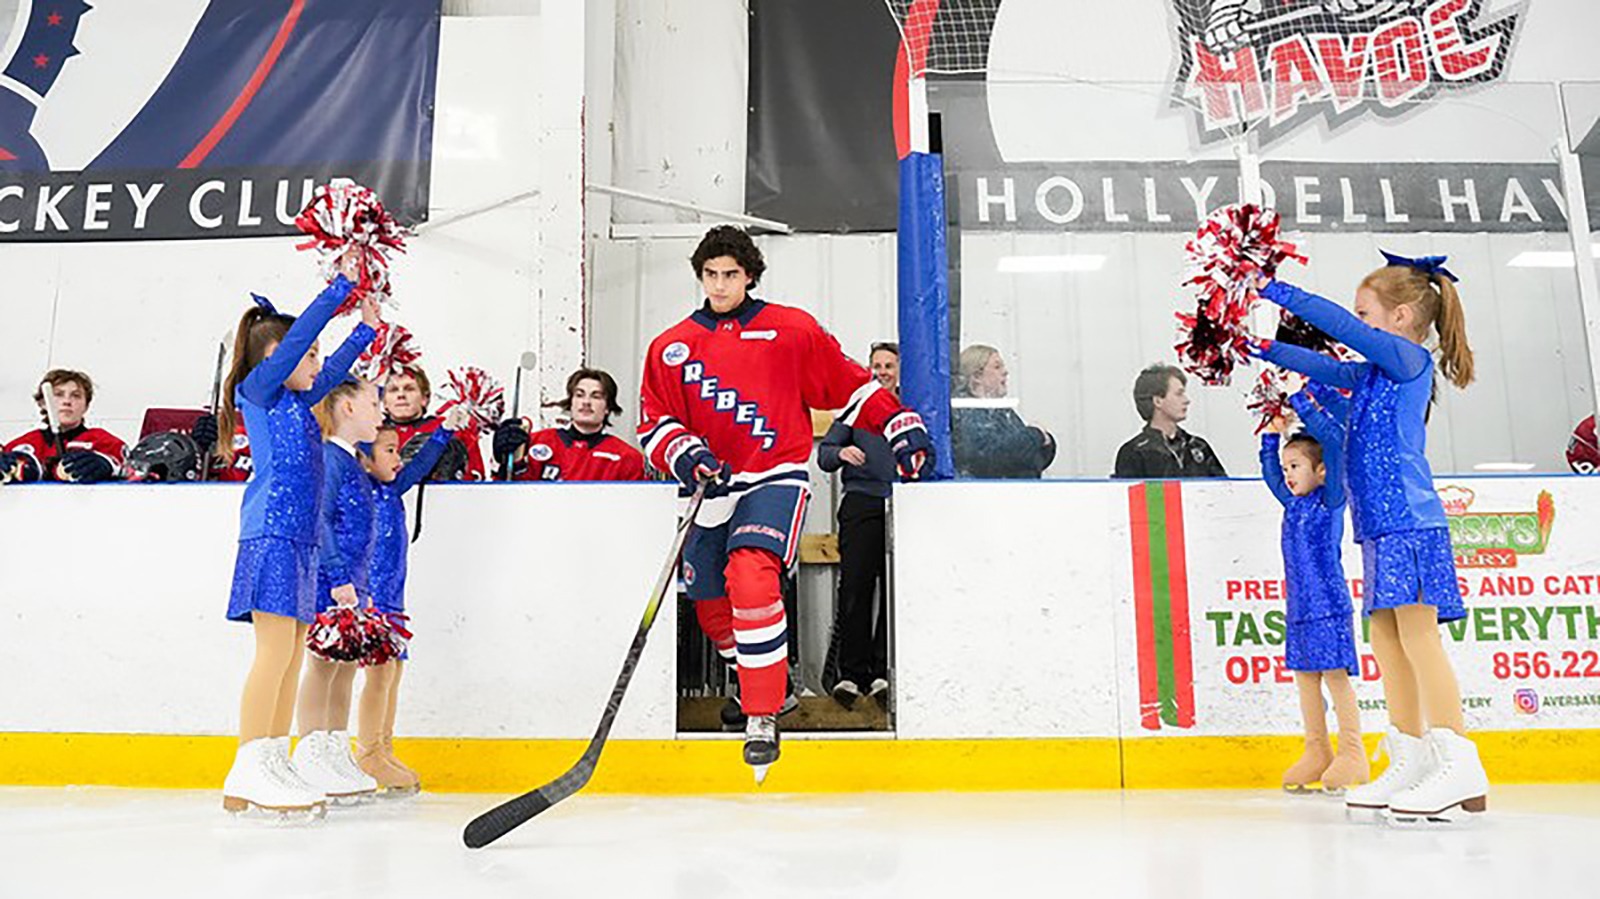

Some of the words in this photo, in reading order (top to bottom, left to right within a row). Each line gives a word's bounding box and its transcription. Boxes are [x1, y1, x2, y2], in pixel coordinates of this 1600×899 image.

[1184, 0, 1503, 131] HAVOC
[189, 177, 357, 229] CLU
[1479, 576, 1534, 596] AND
[1493, 651, 1600, 679] 856.22
